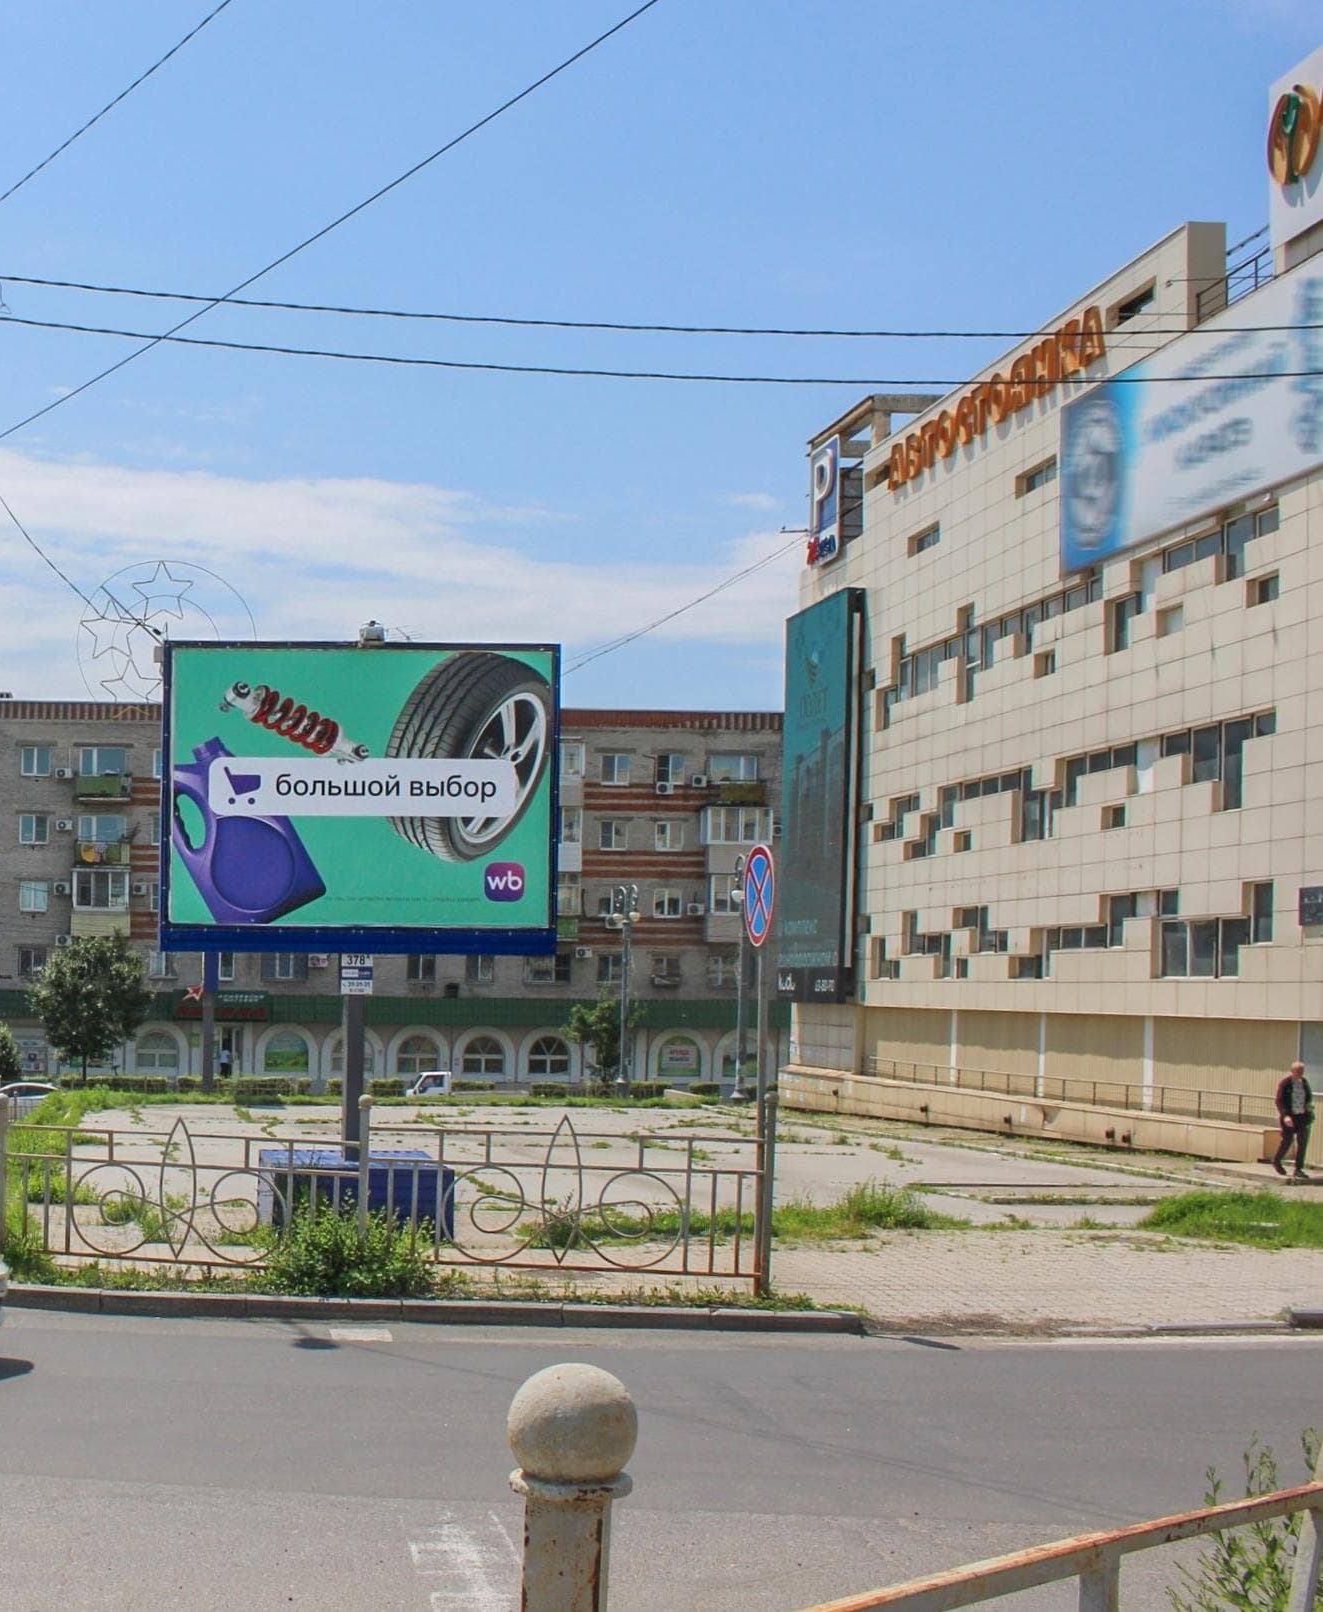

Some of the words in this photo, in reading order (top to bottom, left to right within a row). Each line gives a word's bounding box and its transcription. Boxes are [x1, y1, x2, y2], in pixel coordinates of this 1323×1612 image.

[276, 773, 400, 797] большой
[410, 774, 497, 803] выбор
[487, 870, 522, 890] wb
